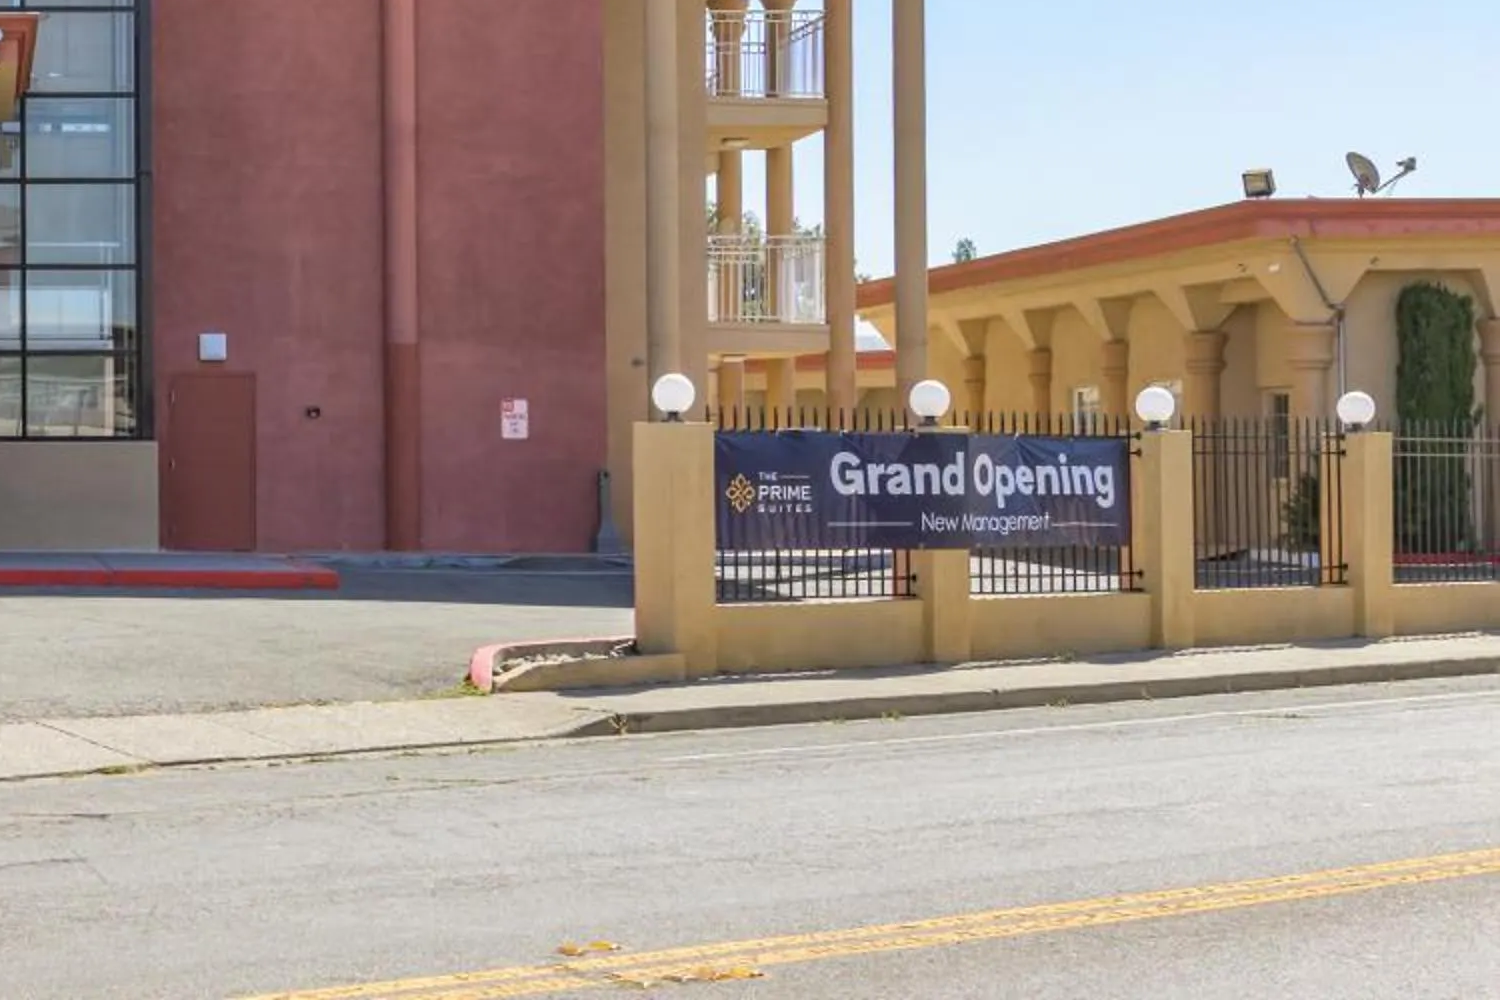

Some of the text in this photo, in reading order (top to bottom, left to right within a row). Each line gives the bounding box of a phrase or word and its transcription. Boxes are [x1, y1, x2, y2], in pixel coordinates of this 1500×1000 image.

[830, 451, 1116, 509] Grand Opening
[758, 485, 812, 501] PRIME
[758, 503, 812, 513] SUITES
[921, 511, 1050, 535] New Management
